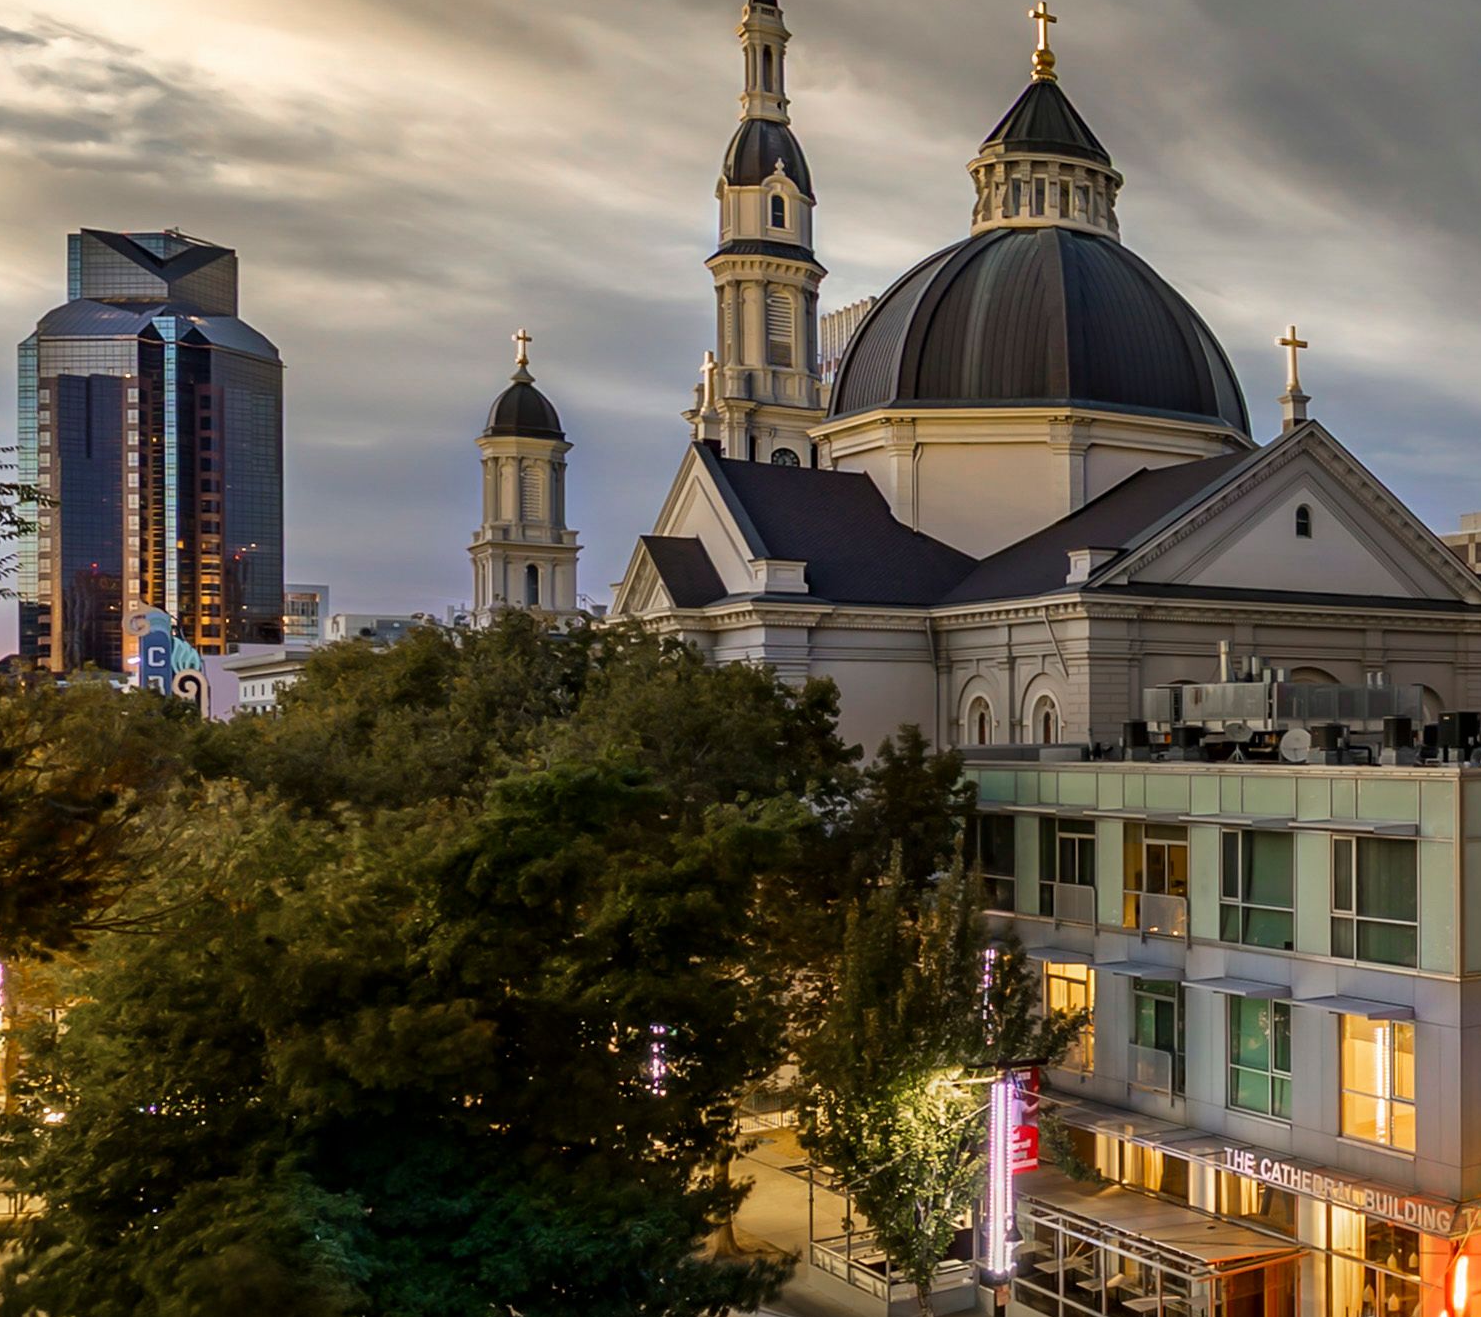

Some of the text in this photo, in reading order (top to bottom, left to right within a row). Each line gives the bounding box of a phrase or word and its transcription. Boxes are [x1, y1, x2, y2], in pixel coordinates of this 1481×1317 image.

[1224, 1146, 1451, 1231] THE CATHEDRAL BUILDING
